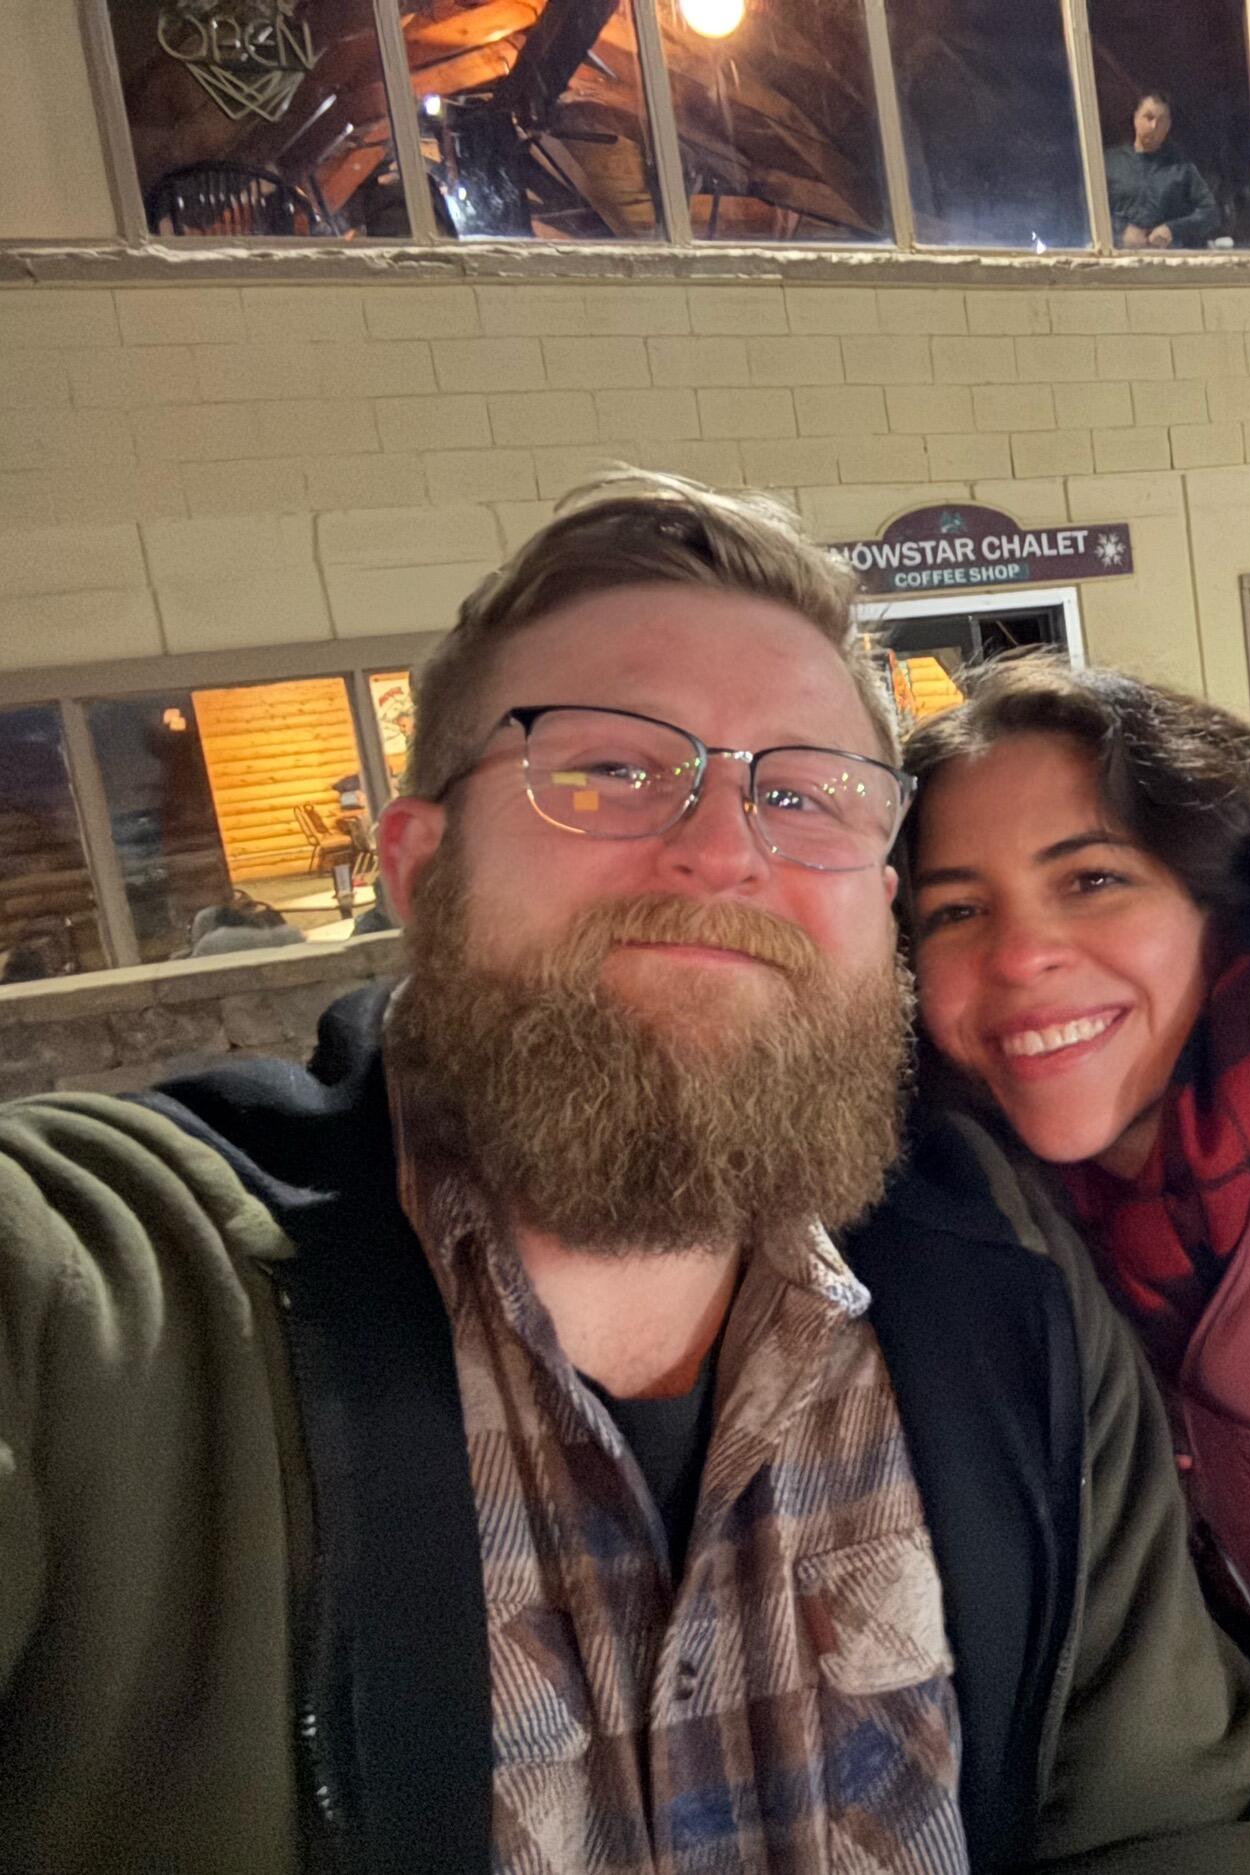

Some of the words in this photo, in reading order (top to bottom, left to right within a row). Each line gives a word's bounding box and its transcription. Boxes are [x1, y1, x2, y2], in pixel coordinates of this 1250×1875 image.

[157, 11, 314, 70] OPEN
[828, 538, 976, 571] NOWSTAR
[981, 529, 1089, 560] CHALET
[894, 568, 967, 588] COFFEE
[969, 564, 1020, 583] SHOP
